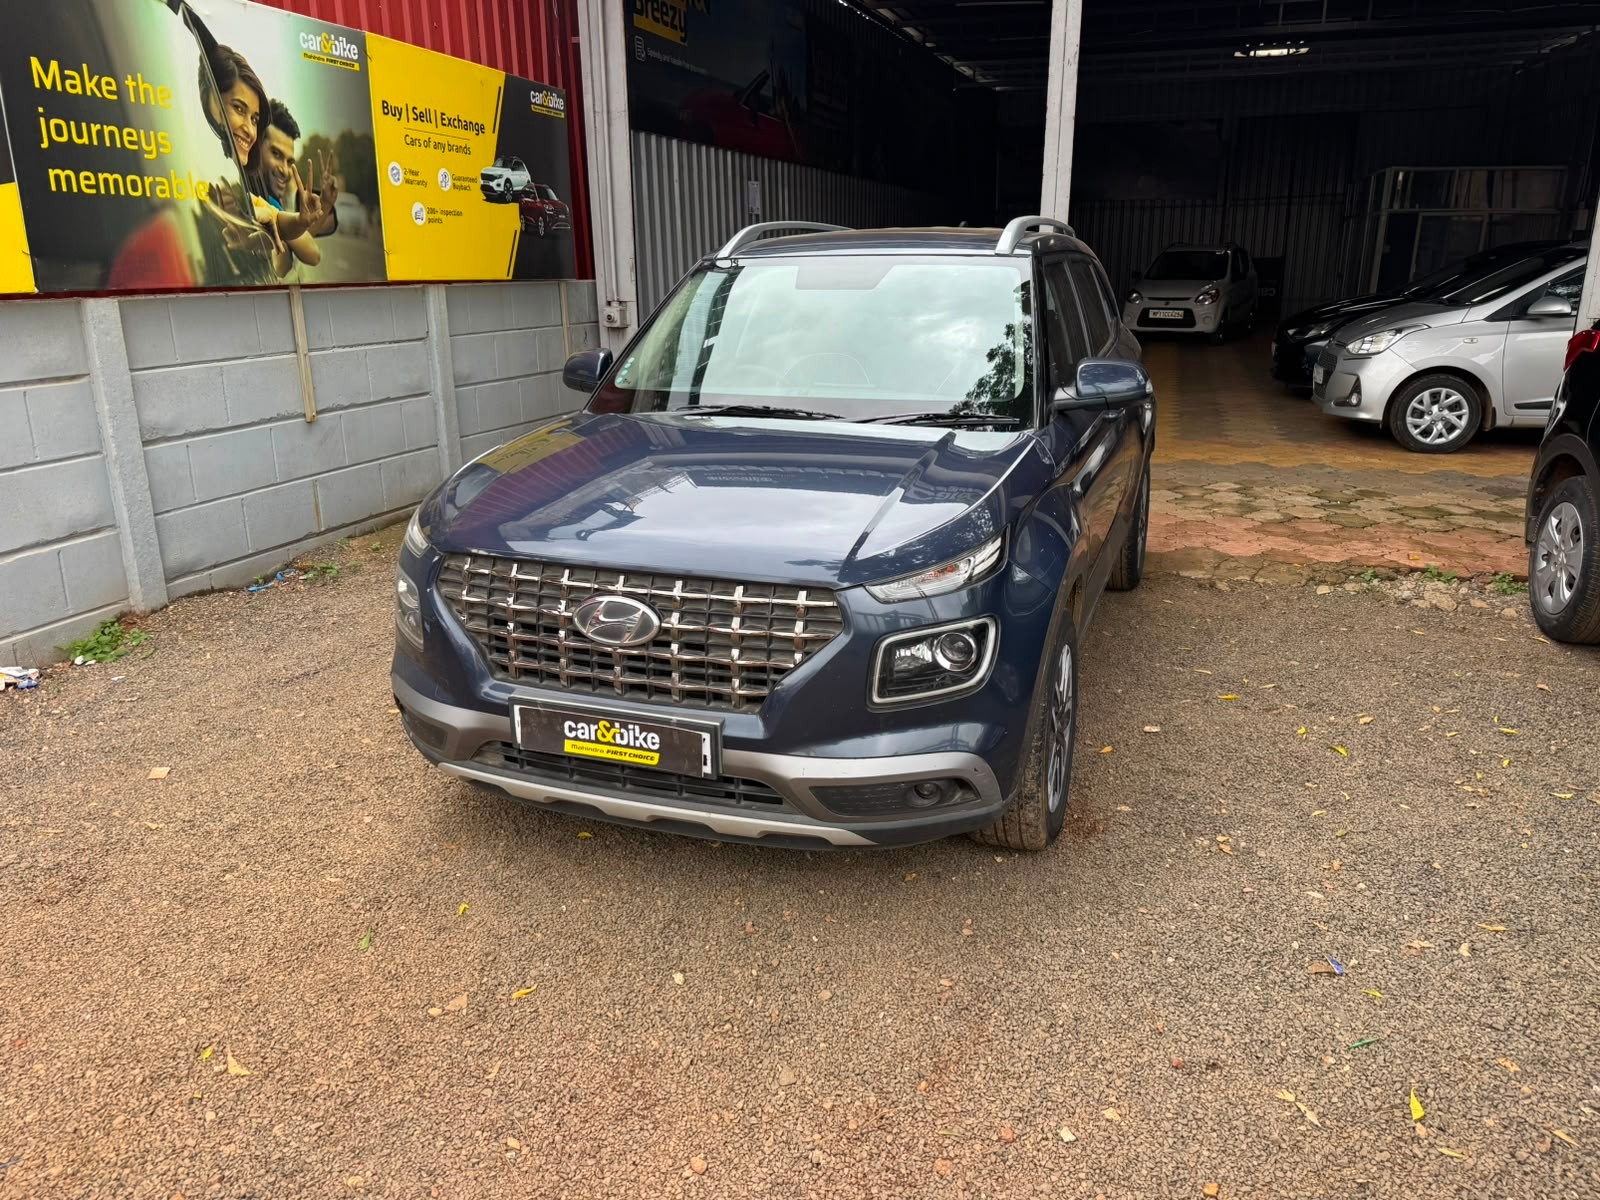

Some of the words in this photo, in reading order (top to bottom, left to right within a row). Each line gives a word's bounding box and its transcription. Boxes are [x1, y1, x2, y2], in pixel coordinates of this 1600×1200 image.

[299, 32, 358, 60] car&bike
[30, 56, 118, 100] Make
[125, 73, 172, 107] the
[38, 107, 172, 160] journeys
[381, 100, 403, 121] Buy
[412, 106, 432, 124] Sell
[440, 112, 486, 136] Exchange
[404, 134, 421, 148] Cars
[423, 137, 431, 149] of
[433, 141, 446, 153] any
[447, 141, 471, 155] brands
[48, 168, 209, 201] memorable
[564, 720, 660, 750] car&bike
[606, 749, 628, 758] FIRST
[628, 753, 655, 761] CHOICE
